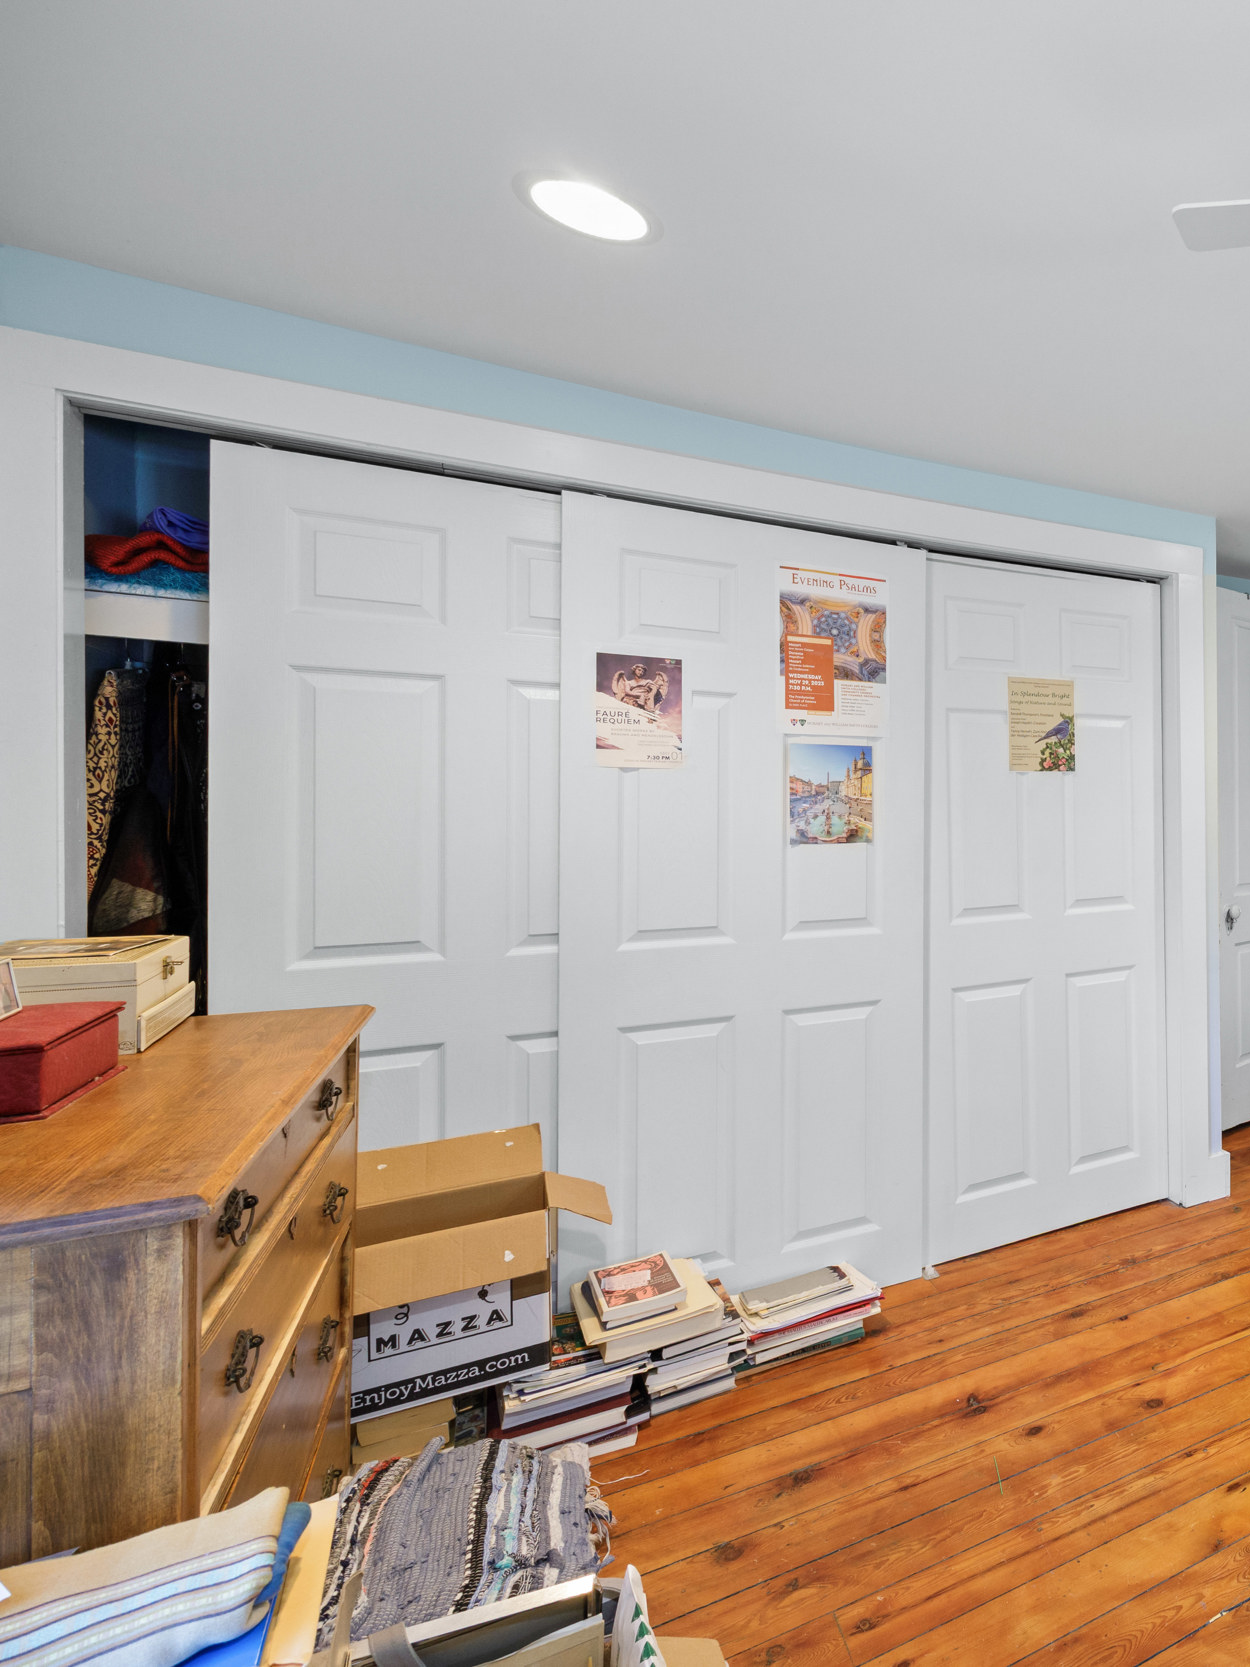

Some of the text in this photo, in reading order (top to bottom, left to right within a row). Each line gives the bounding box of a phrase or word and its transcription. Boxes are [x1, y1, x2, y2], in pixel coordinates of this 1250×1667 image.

[595, 709, 630, 718] FAURÉ
[595, 717, 641, 725] REQUIEM
[375, 1308, 509, 1355] MAZZA
[350, 1351, 530, 1411] EnjoyMazza.com
